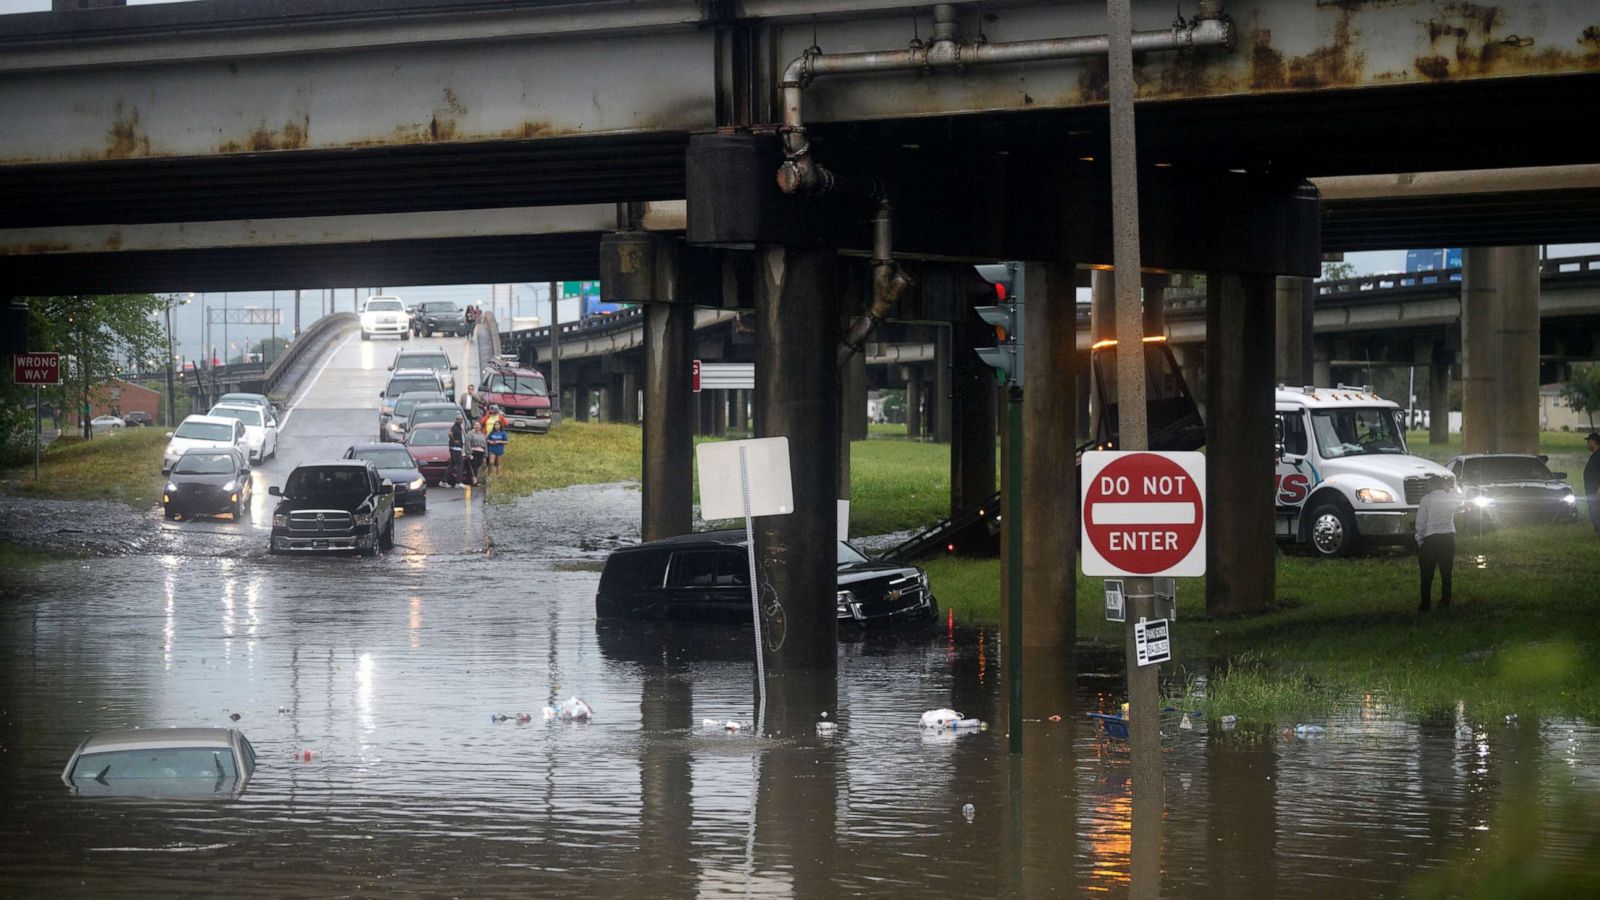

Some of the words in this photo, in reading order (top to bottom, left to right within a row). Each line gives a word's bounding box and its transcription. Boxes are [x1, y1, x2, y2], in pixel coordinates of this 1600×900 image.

[17, 356, 57, 368] WRONG
[24, 369, 49, 380] WAY
[1100, 476, 1130, 496] DO
[1143, 475, 1186, 496] NOT
[1109, 531, 1178, 551] ENTER
